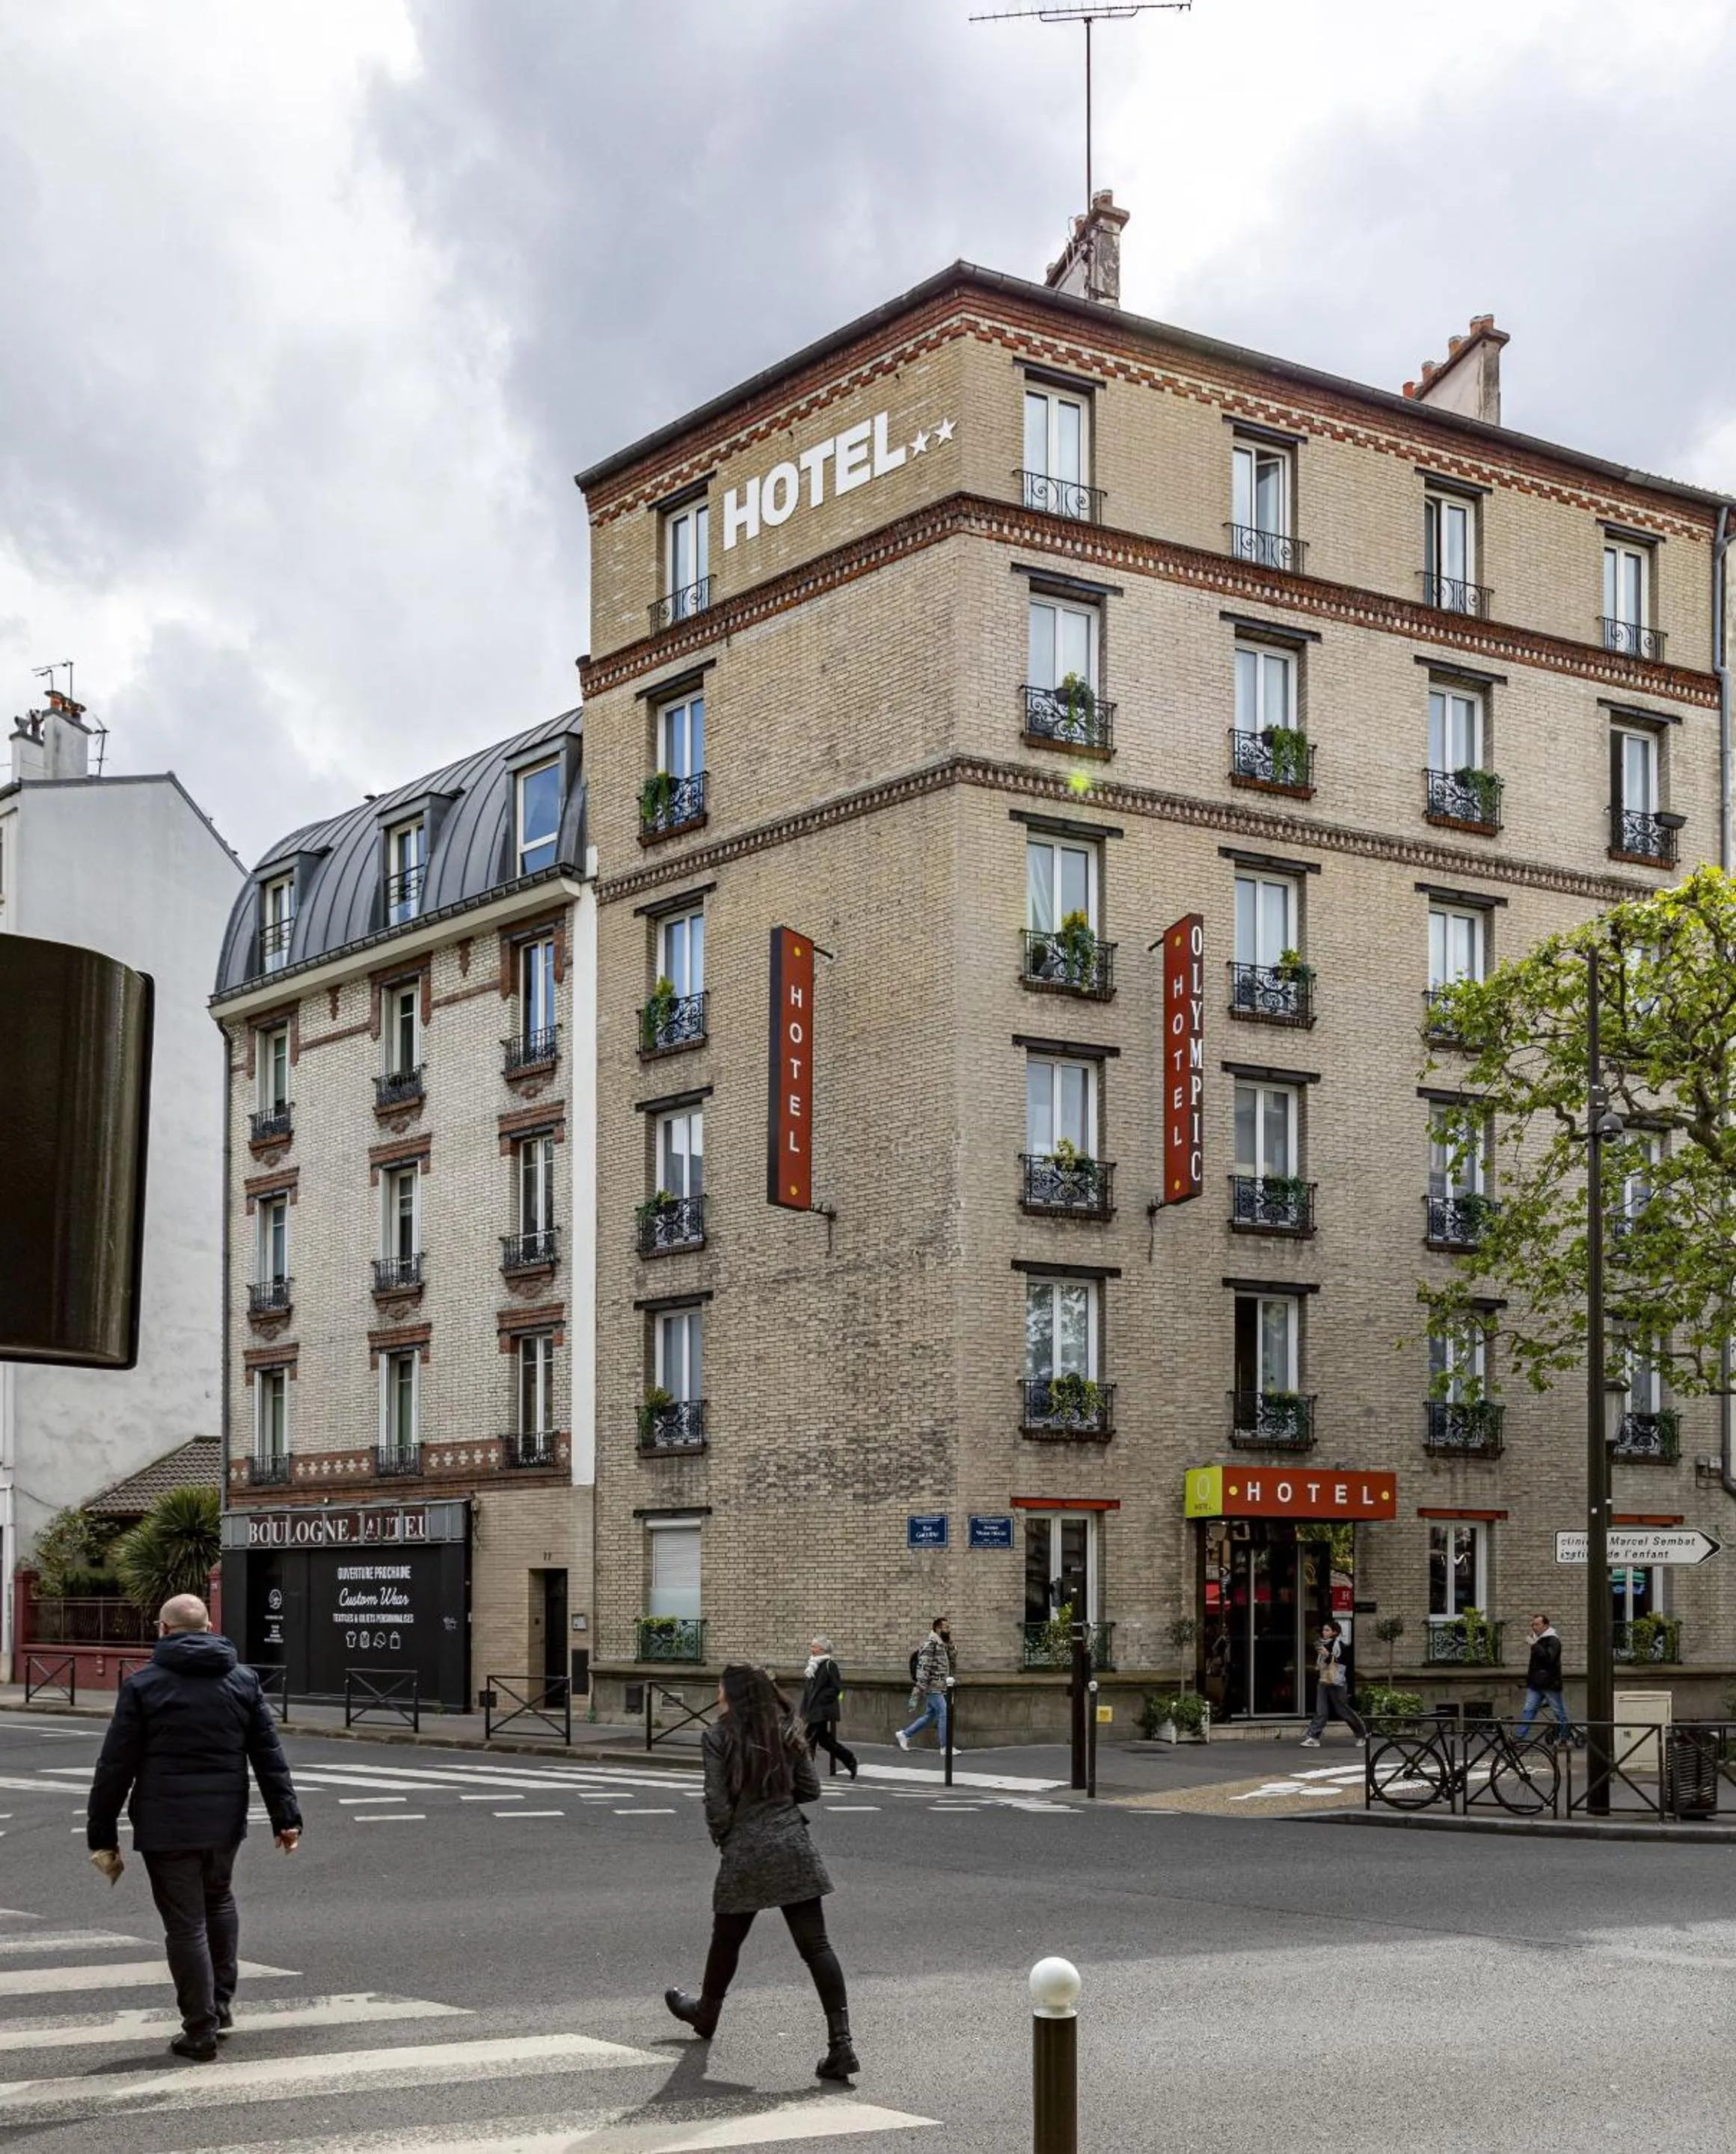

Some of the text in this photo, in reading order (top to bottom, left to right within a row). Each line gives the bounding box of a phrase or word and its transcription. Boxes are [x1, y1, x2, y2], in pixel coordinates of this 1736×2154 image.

[723, 411, 907, 551] HOTEL
[1173, 975, 1183, 1147] HOTEL
[1190, 925, 1203, 1182] OLYMPIC
[789, 984, 803, 1153] HOTEL
[1247, 1481, 1375, 1505] HOTEL
[249, 1519, 350, 1544] BOULOGNE
[1561, 1535, 1696, 1546] clini Marcel Sembat
[1625, 1549, 1669, 1559] l'enfant
[337, 1566, 374, 1580] OUVERTURE
[339, 1586, 410, 1606] Custom Wear
